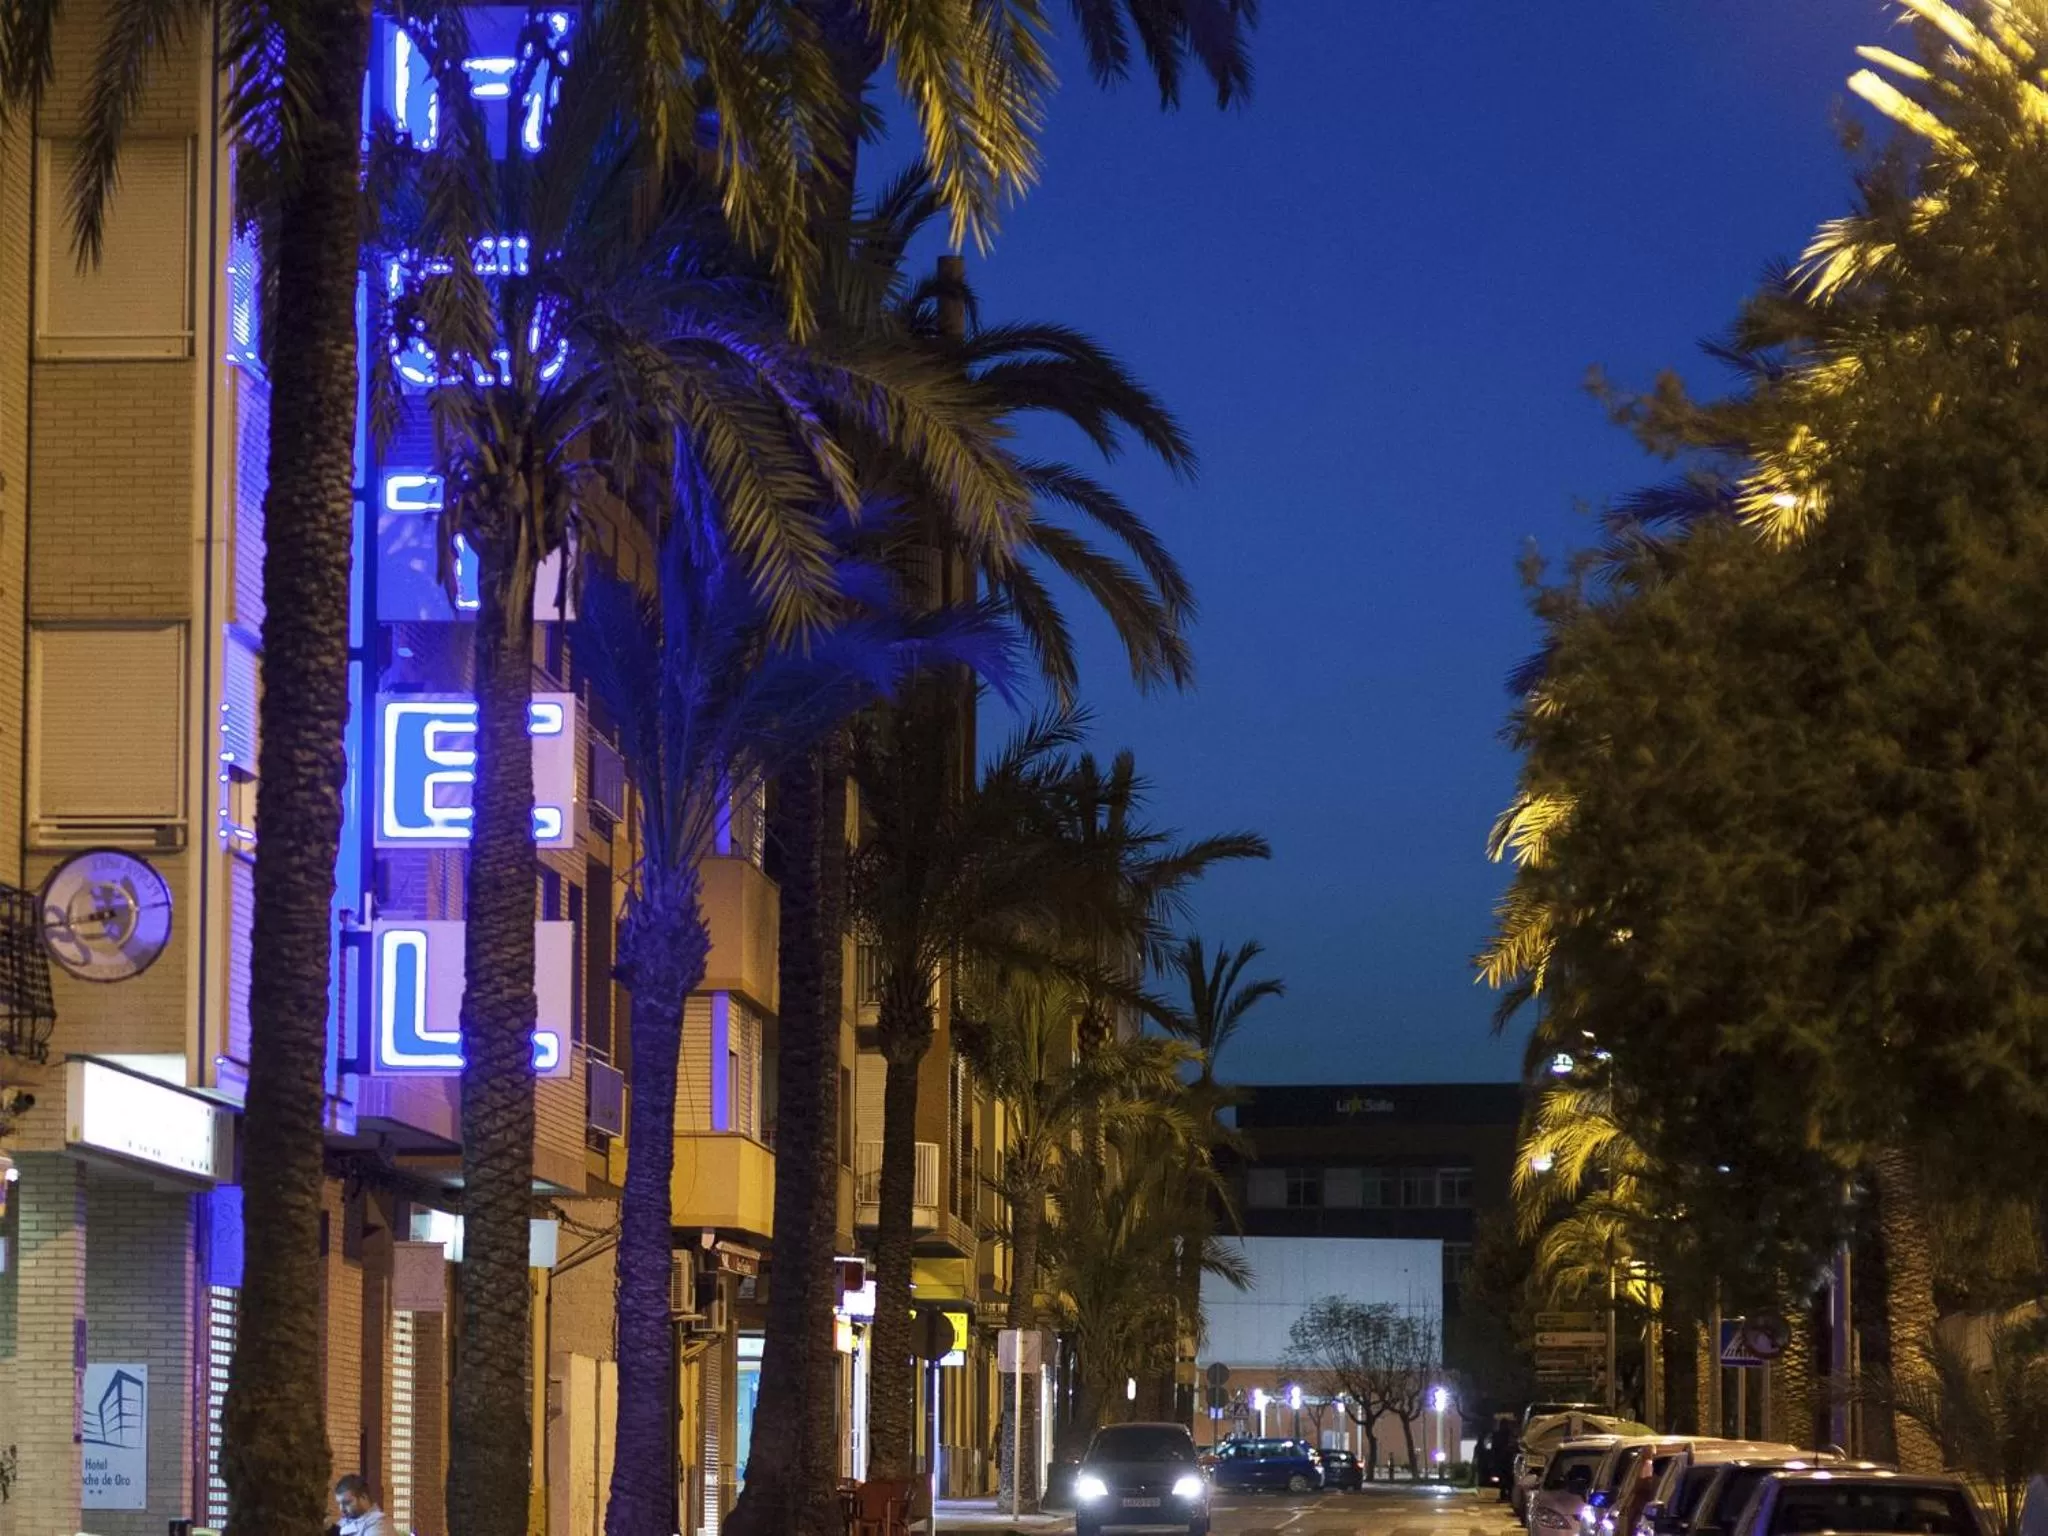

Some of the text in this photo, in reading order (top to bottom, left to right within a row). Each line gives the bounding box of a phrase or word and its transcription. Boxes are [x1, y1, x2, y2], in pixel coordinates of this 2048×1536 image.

[84, 1456, 108, 1471] Hotel
[102, 1471, 113, 1486] de
[115, 1473, 132, 1487] Oro
